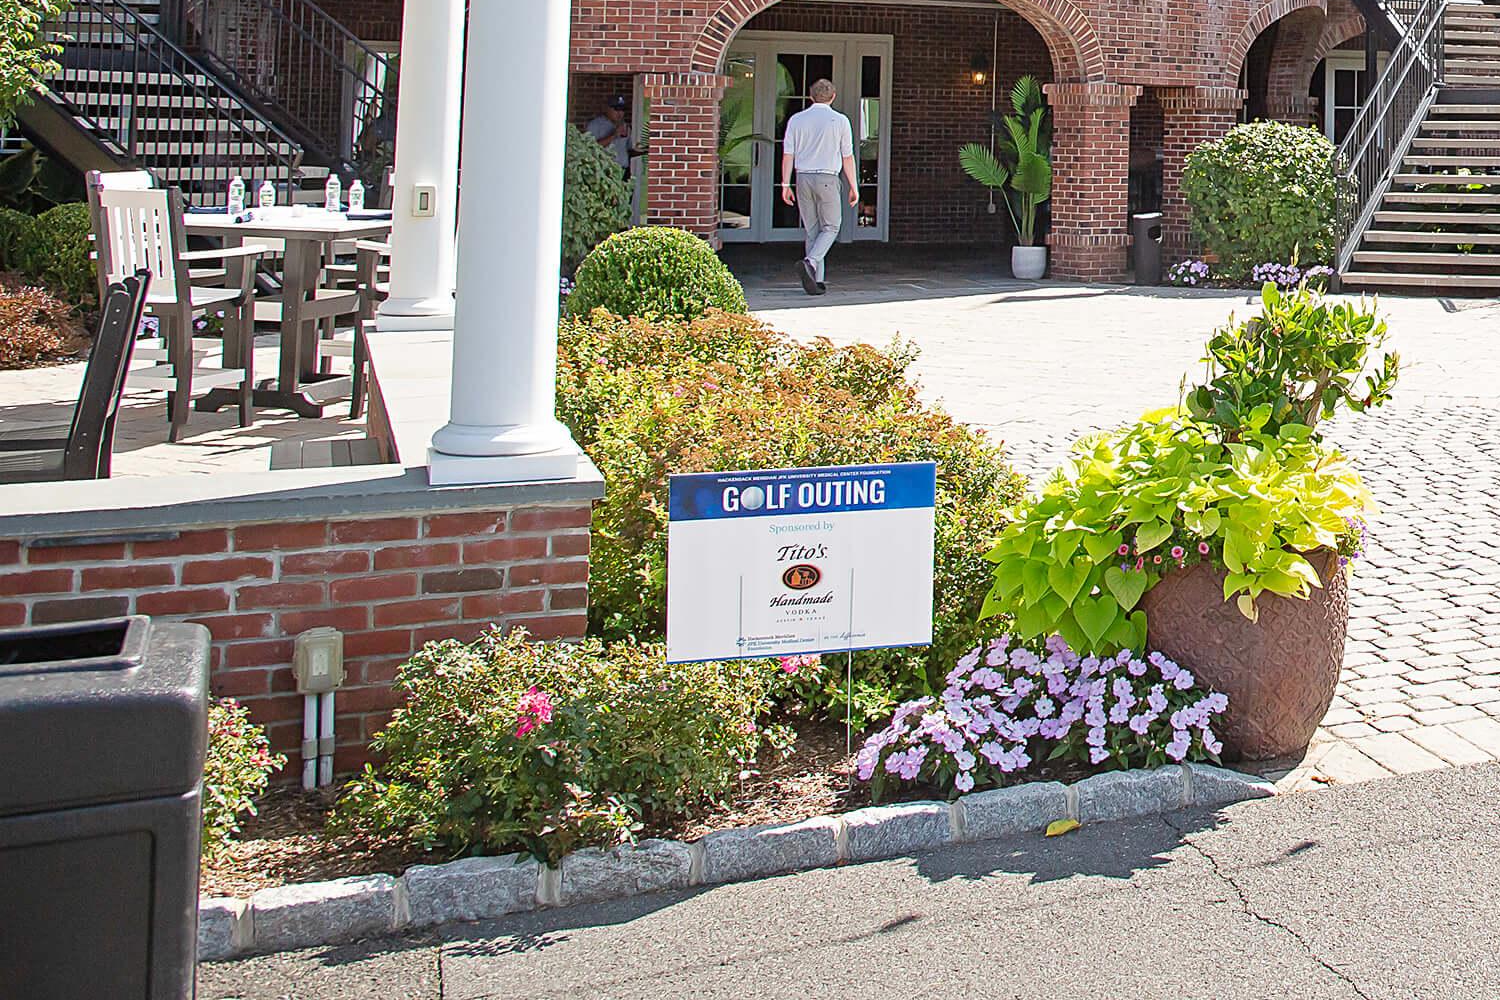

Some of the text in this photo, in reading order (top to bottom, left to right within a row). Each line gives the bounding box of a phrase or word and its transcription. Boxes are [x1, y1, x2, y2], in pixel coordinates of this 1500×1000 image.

[722, 478, 885, 512] GOLF OUTING
[769, 520, 833, 534] Sponsored by
[777, 543, 828, 562] Tito's
[769, 591, 834, 607] Handmade
